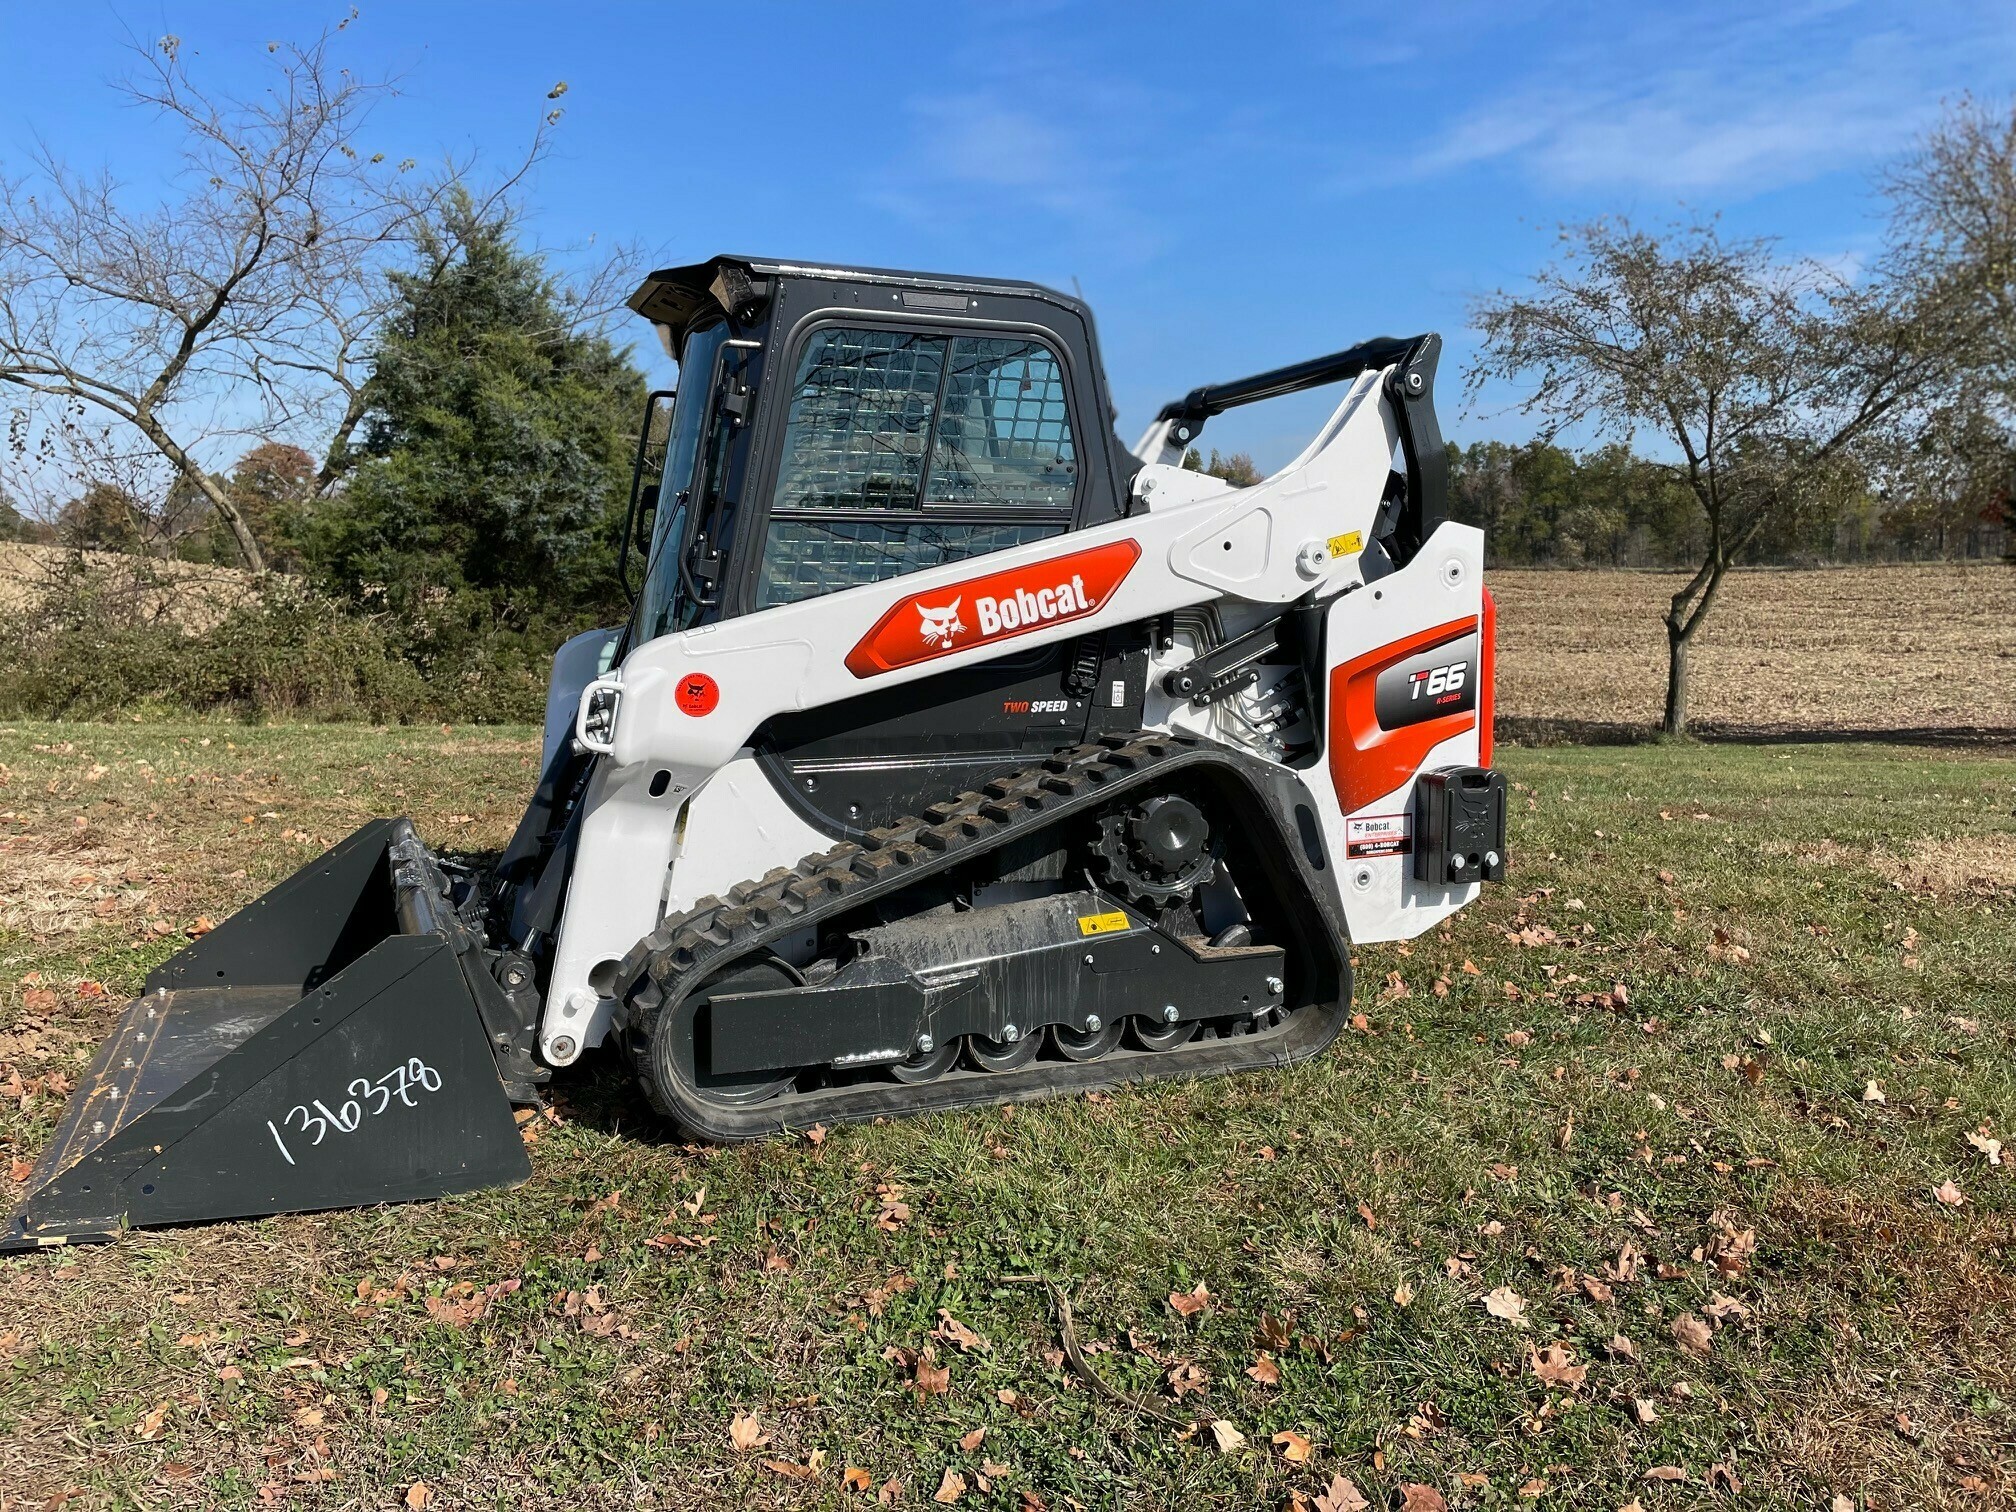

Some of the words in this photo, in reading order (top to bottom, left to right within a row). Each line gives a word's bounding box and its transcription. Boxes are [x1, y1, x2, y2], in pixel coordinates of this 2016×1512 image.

[975, 574, 1089, 636] Bobcat
[1408, 661, 1468, 700] T66
[1003, 702, 1029, 713] TWO
[1031, 700, 1068, 713] SPEED
[1436, 692, 1462, 704] R-SERIES
[1365, 822, 1390, 831] Bobcat
[267, 1057, 442, 1165] 136378
